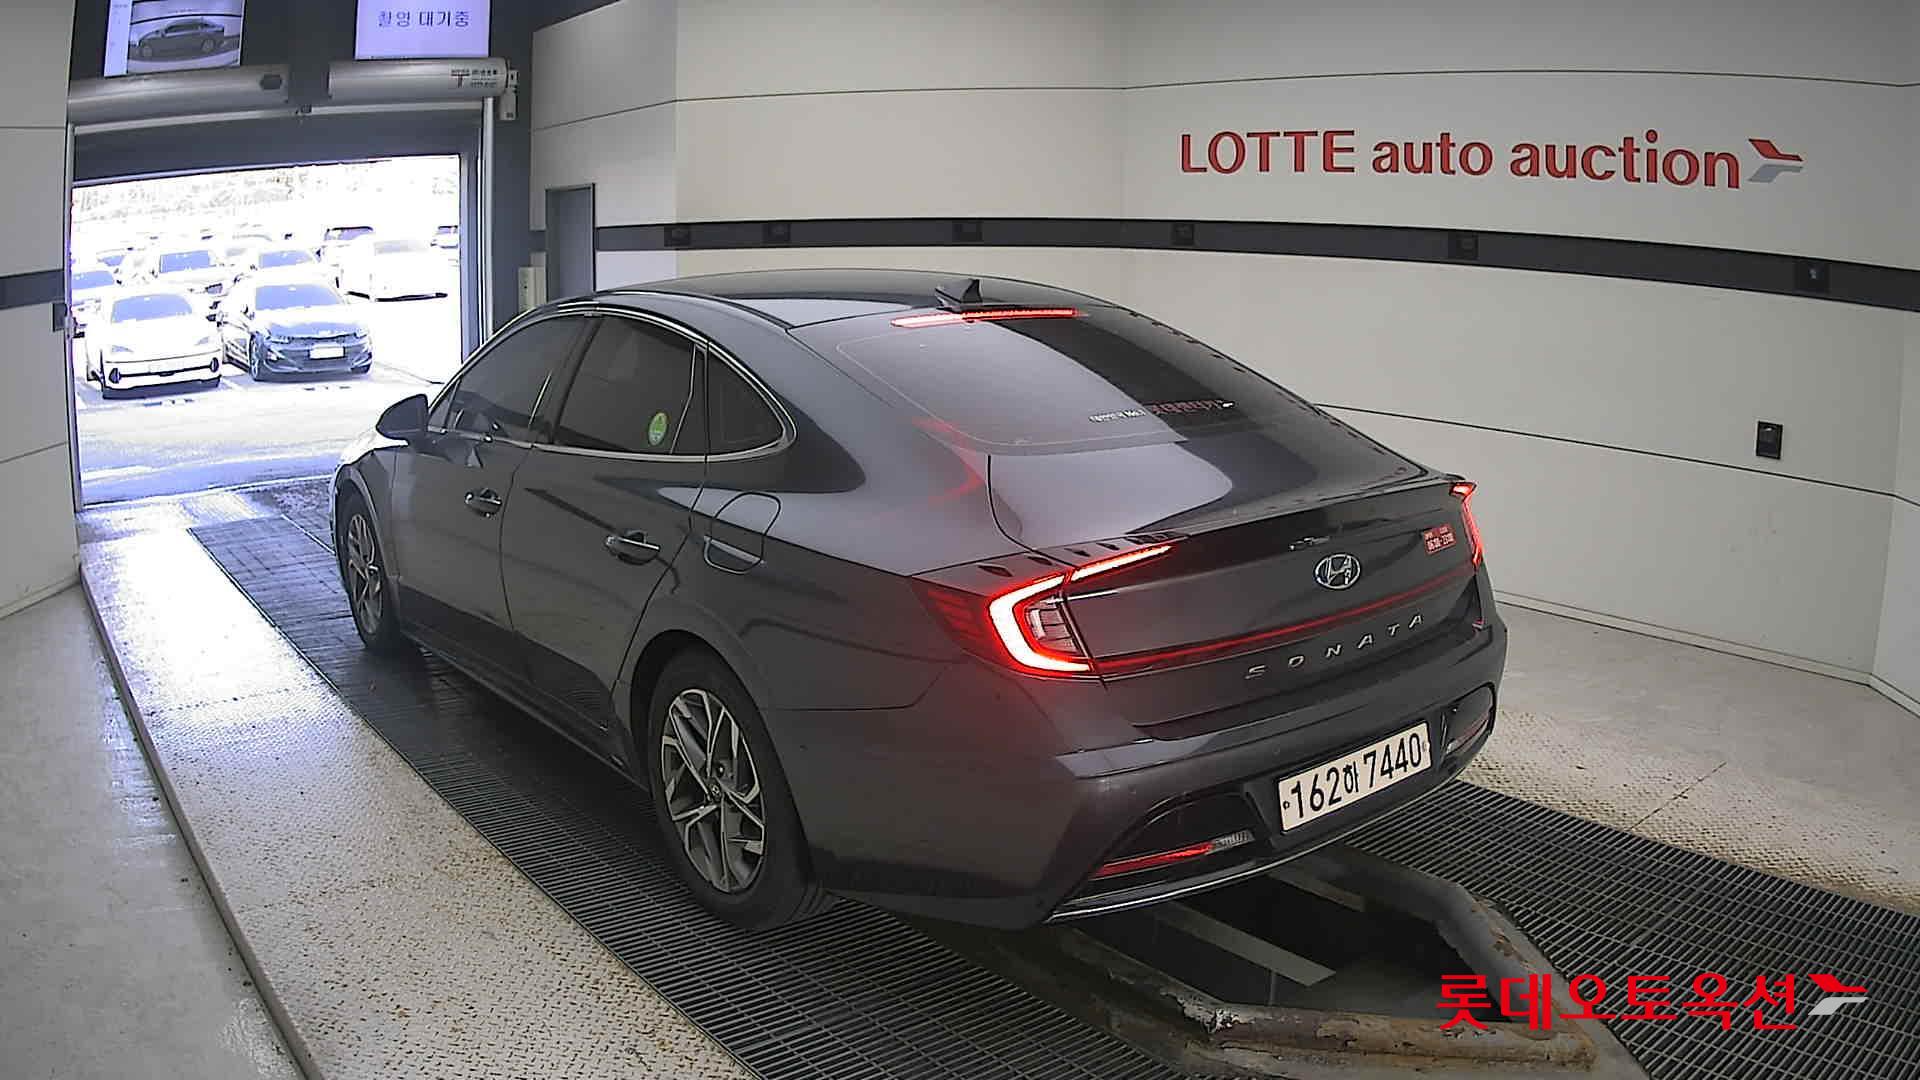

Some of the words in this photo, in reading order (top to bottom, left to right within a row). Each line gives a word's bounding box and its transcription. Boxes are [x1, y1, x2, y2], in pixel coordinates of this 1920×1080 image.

[418, 10, 469, 28] 대기중
[1181, 129, 1355, 174] LOTTE
[1373, 132, 1494, 176] auto
[1511, 130, 1741, 189] auction
[1244, 613, 1425, 679] SONATA
[1291, 761, 1360, 818] 162하
[1363, 733, 1422, 788] 7440
